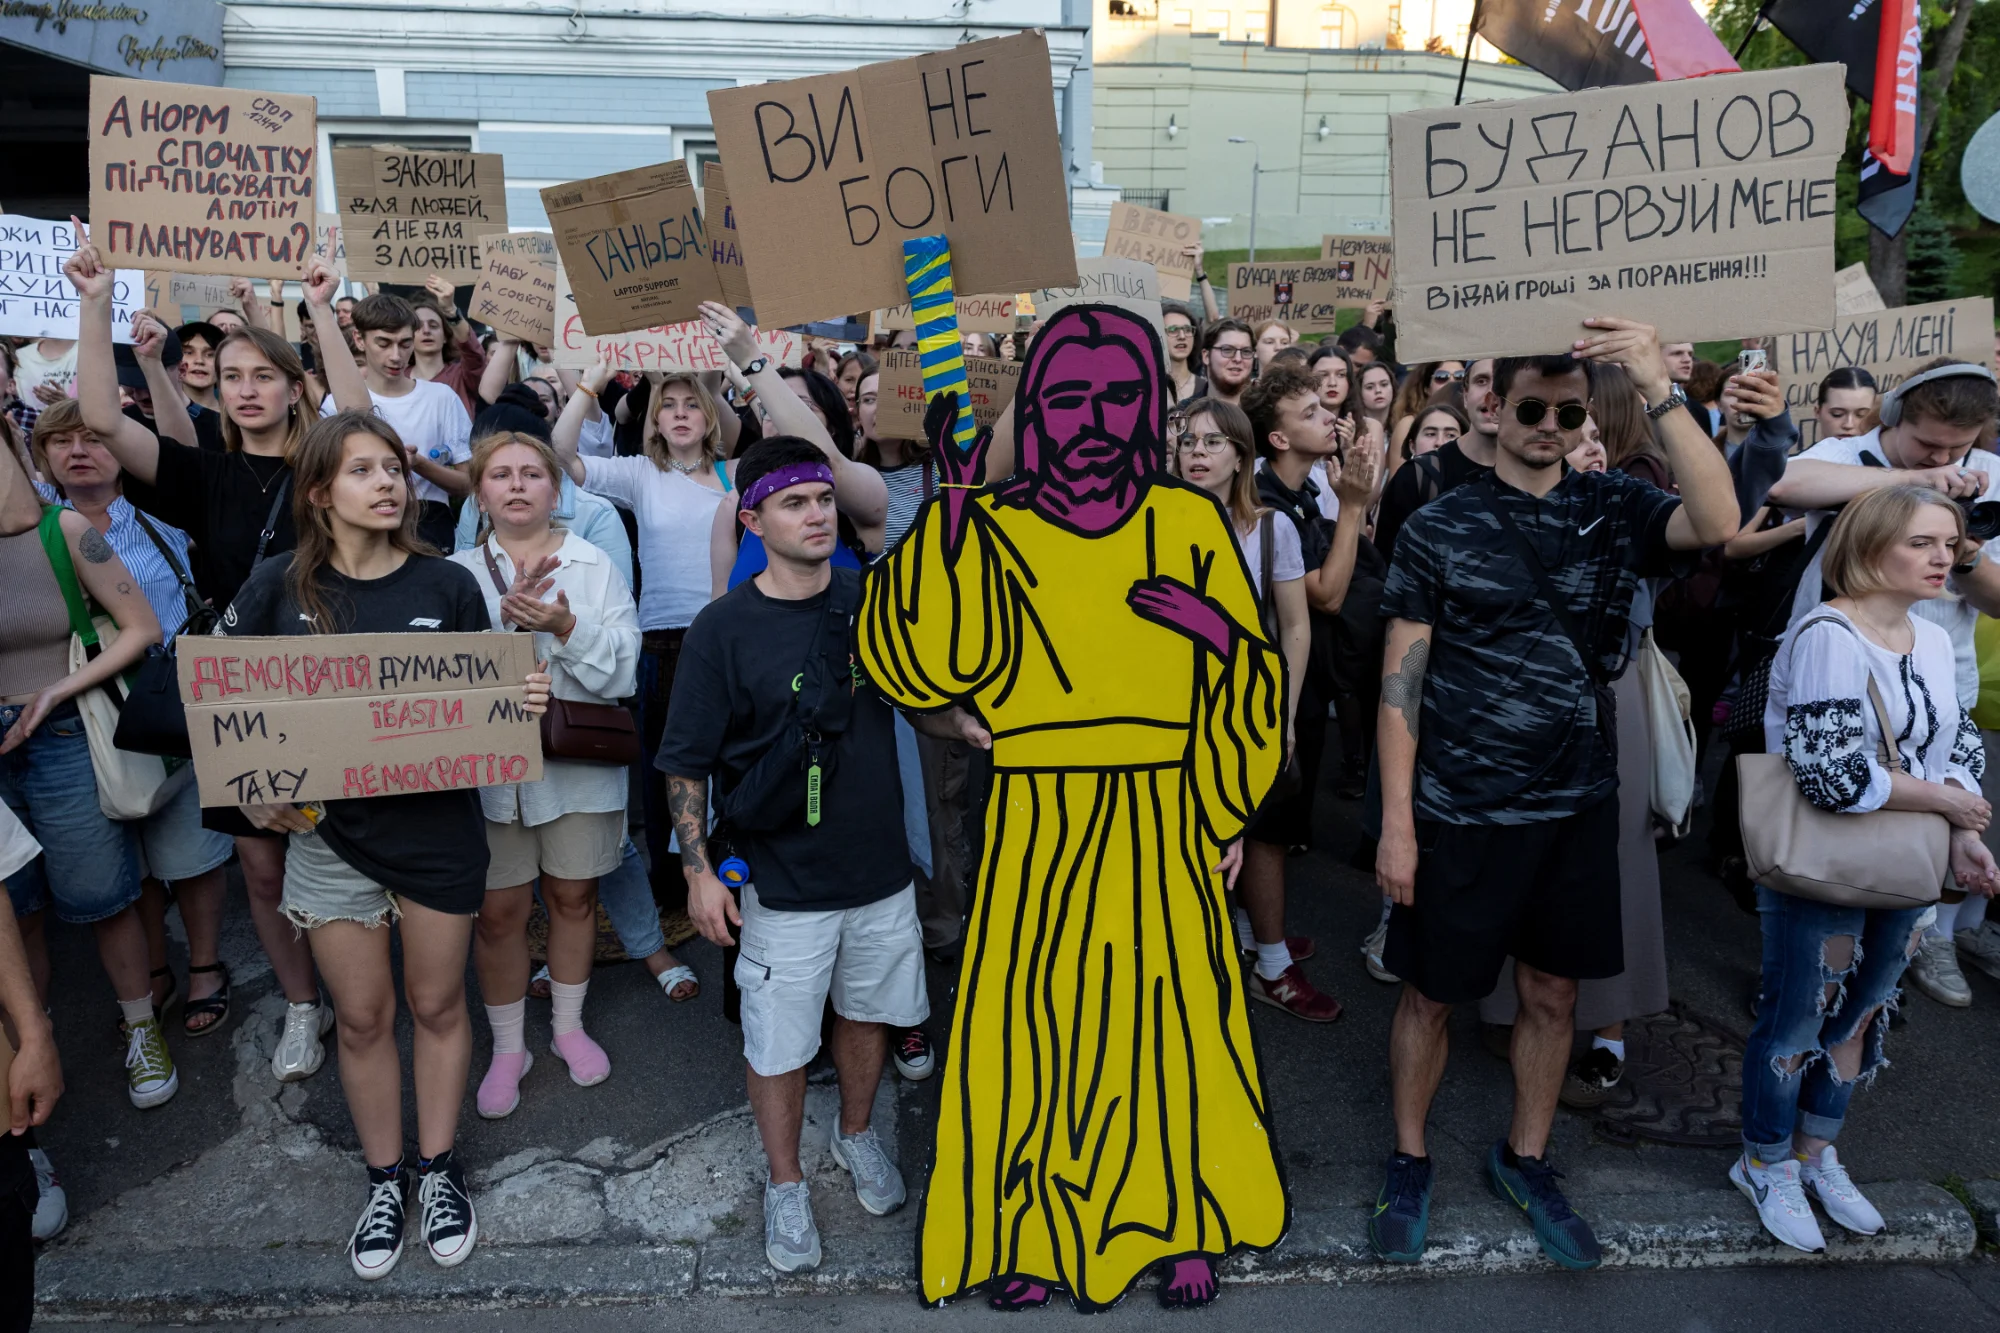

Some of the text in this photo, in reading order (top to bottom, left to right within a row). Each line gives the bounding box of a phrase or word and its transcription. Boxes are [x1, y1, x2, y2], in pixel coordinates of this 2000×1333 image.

[102, 95, 229, 138] А НОРМ
[252, 97, 293, 123] СТОП
[754, 59, 992, 184] ВИ НЕ
[158, 138, 313, 175] СПОЧАТКУ
[1426, 89, 1814, 199] БУДАНОВ
[382, 155, 476, 189] ЗАКОНИ
[206, 198, 225, 221] А
[350, 195, 489, 222] ДЛЯ ЛЮДЕЙ,
[838, 151, 1014, 246] БОГИ
[372, 219, 463, 240] А НЕ ДЛЯ
[1122, 207, 1190, 240] ВЕТО
[1432, 177, 1836, 267] НЕ НЕРВУЙ МЕНЕ
[108, 220, 310, 271] ПЛАНУВАТИ?
[585, 206, 707, 283] ГАНЬБА!
[481, 280, 492, 292] А
[489, 260, 528, 281] НАБУ
[613, 285, 644, 297] LAPTOP
[644, 278, 679, 292] SUPPORT
[1587, 275, 1611, 291] ЗА
[1618, 254, 1767, 288] ПОРАНЕННЯ!!!
[1792, 318, 1879, 374] НАХУЯ
[378, 653, 500, 690] ДУМАЛИ
[213, 710, 287, 747] МИ,
[226, 767, 308, 804] ТАКУ
